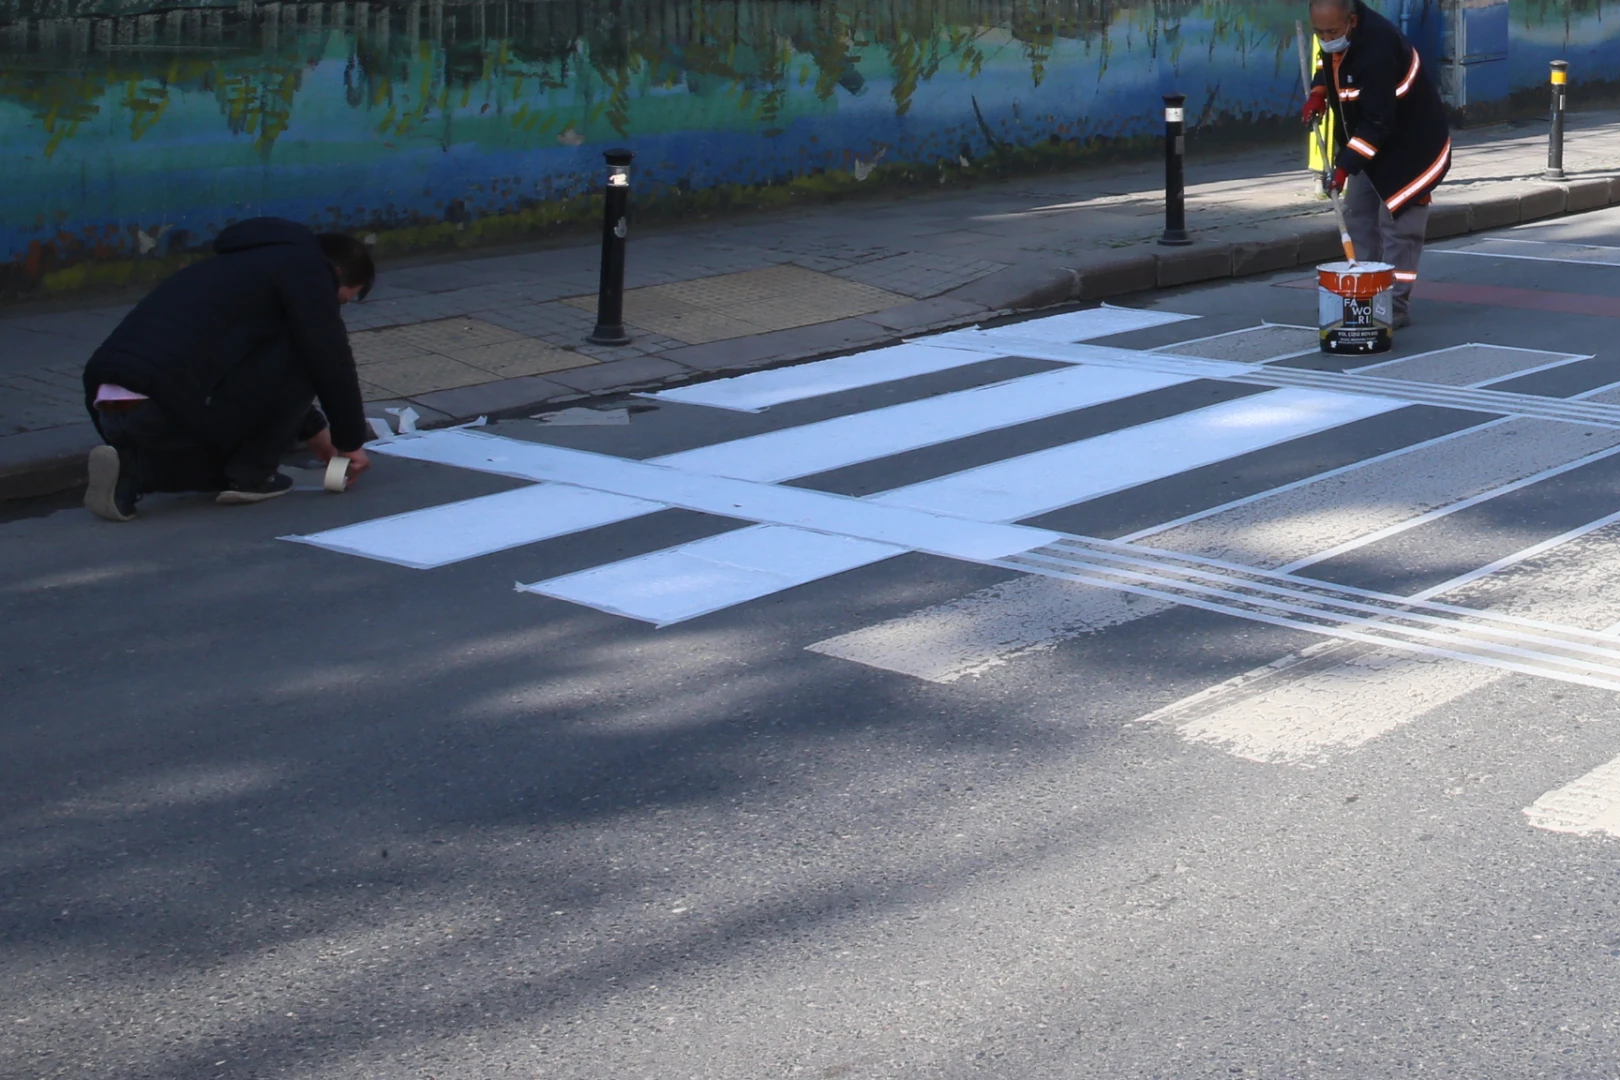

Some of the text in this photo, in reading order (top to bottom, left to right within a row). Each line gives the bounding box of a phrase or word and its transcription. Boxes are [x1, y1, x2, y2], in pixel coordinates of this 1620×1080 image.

[1344, 298, 1358, 307] FA
[1352, 306, 1372, 316] WO
[1358, 315, 1369, 324] RI
